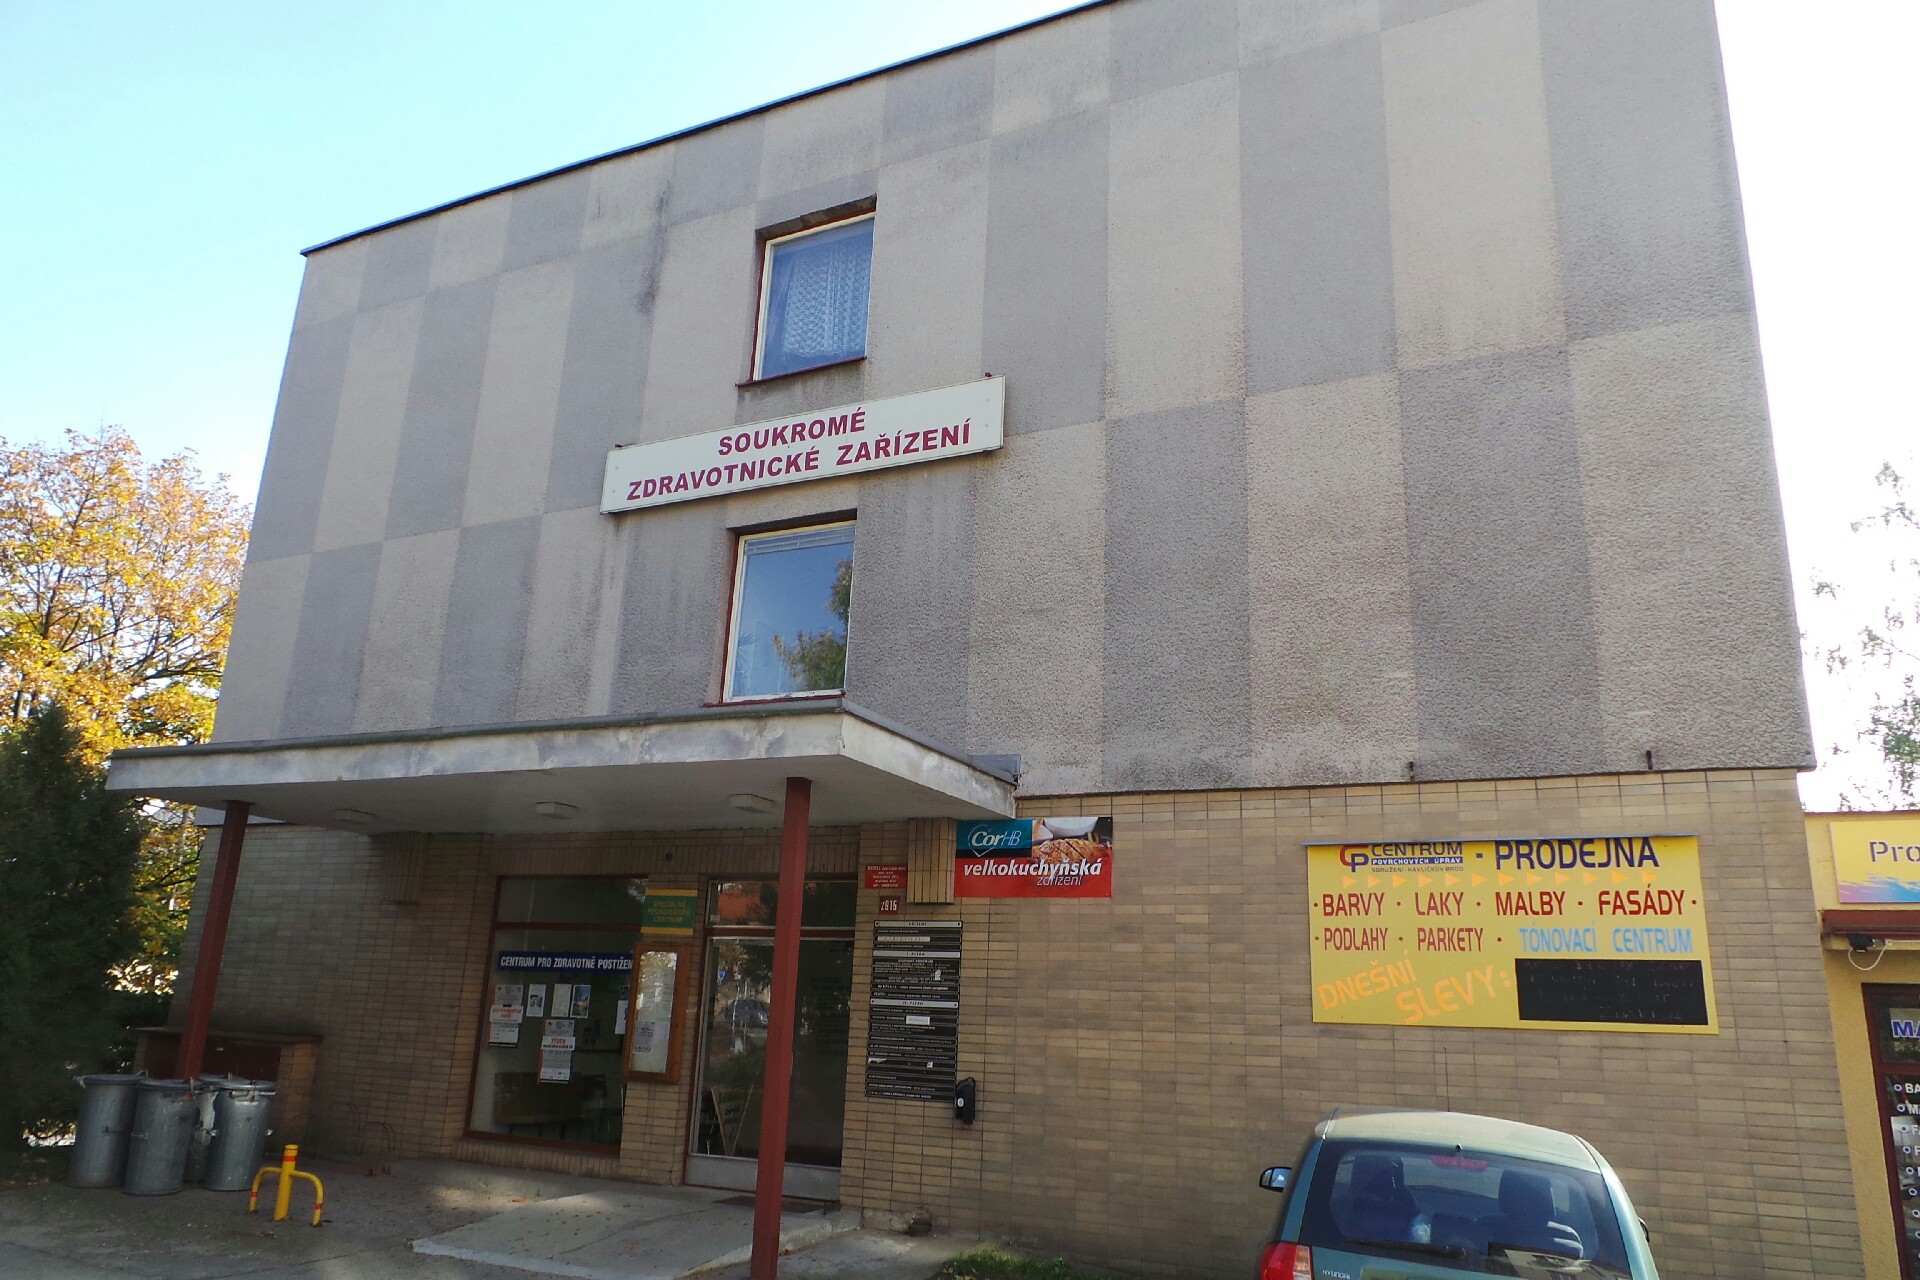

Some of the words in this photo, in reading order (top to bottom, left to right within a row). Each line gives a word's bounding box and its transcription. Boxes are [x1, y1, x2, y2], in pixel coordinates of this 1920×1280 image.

[718, 407, 867, 456] SOUKROMÉ
[627, 445, 820, 501] ZDRAVOTNICKÉ
[836, 417, 971, 467] ZAŘÍZENÍ
[964, 858, 1102, 880] velkokuchyňská
[1371, 842, 1463, 857] CENTRUM
[1495, 837, 1660, 871] PRODEJNA
[1372, 858, 1429, 866] POVRCHOVÝCH
[1434, 856, 1461, 865] ÚPRAV
[1322, 892, 1385, 917] BARVY
[1415, 892, 1464, 917] LAKY
[1495, 890, 1566, 916] MALBY
[1598, 884, 1685, 916] FASÁDY
[1324, 927, 1389, 952] PODLAHY
[1417, 927, 1483, 952] PARKETY
[1612, 927, 1692, 954] CENTRUM
[501, 956, 535, 967] CENTRUM
[537, 957, 552, 968] PRO
[1317, 950, 1417, 1010] DNEŠNÍ
